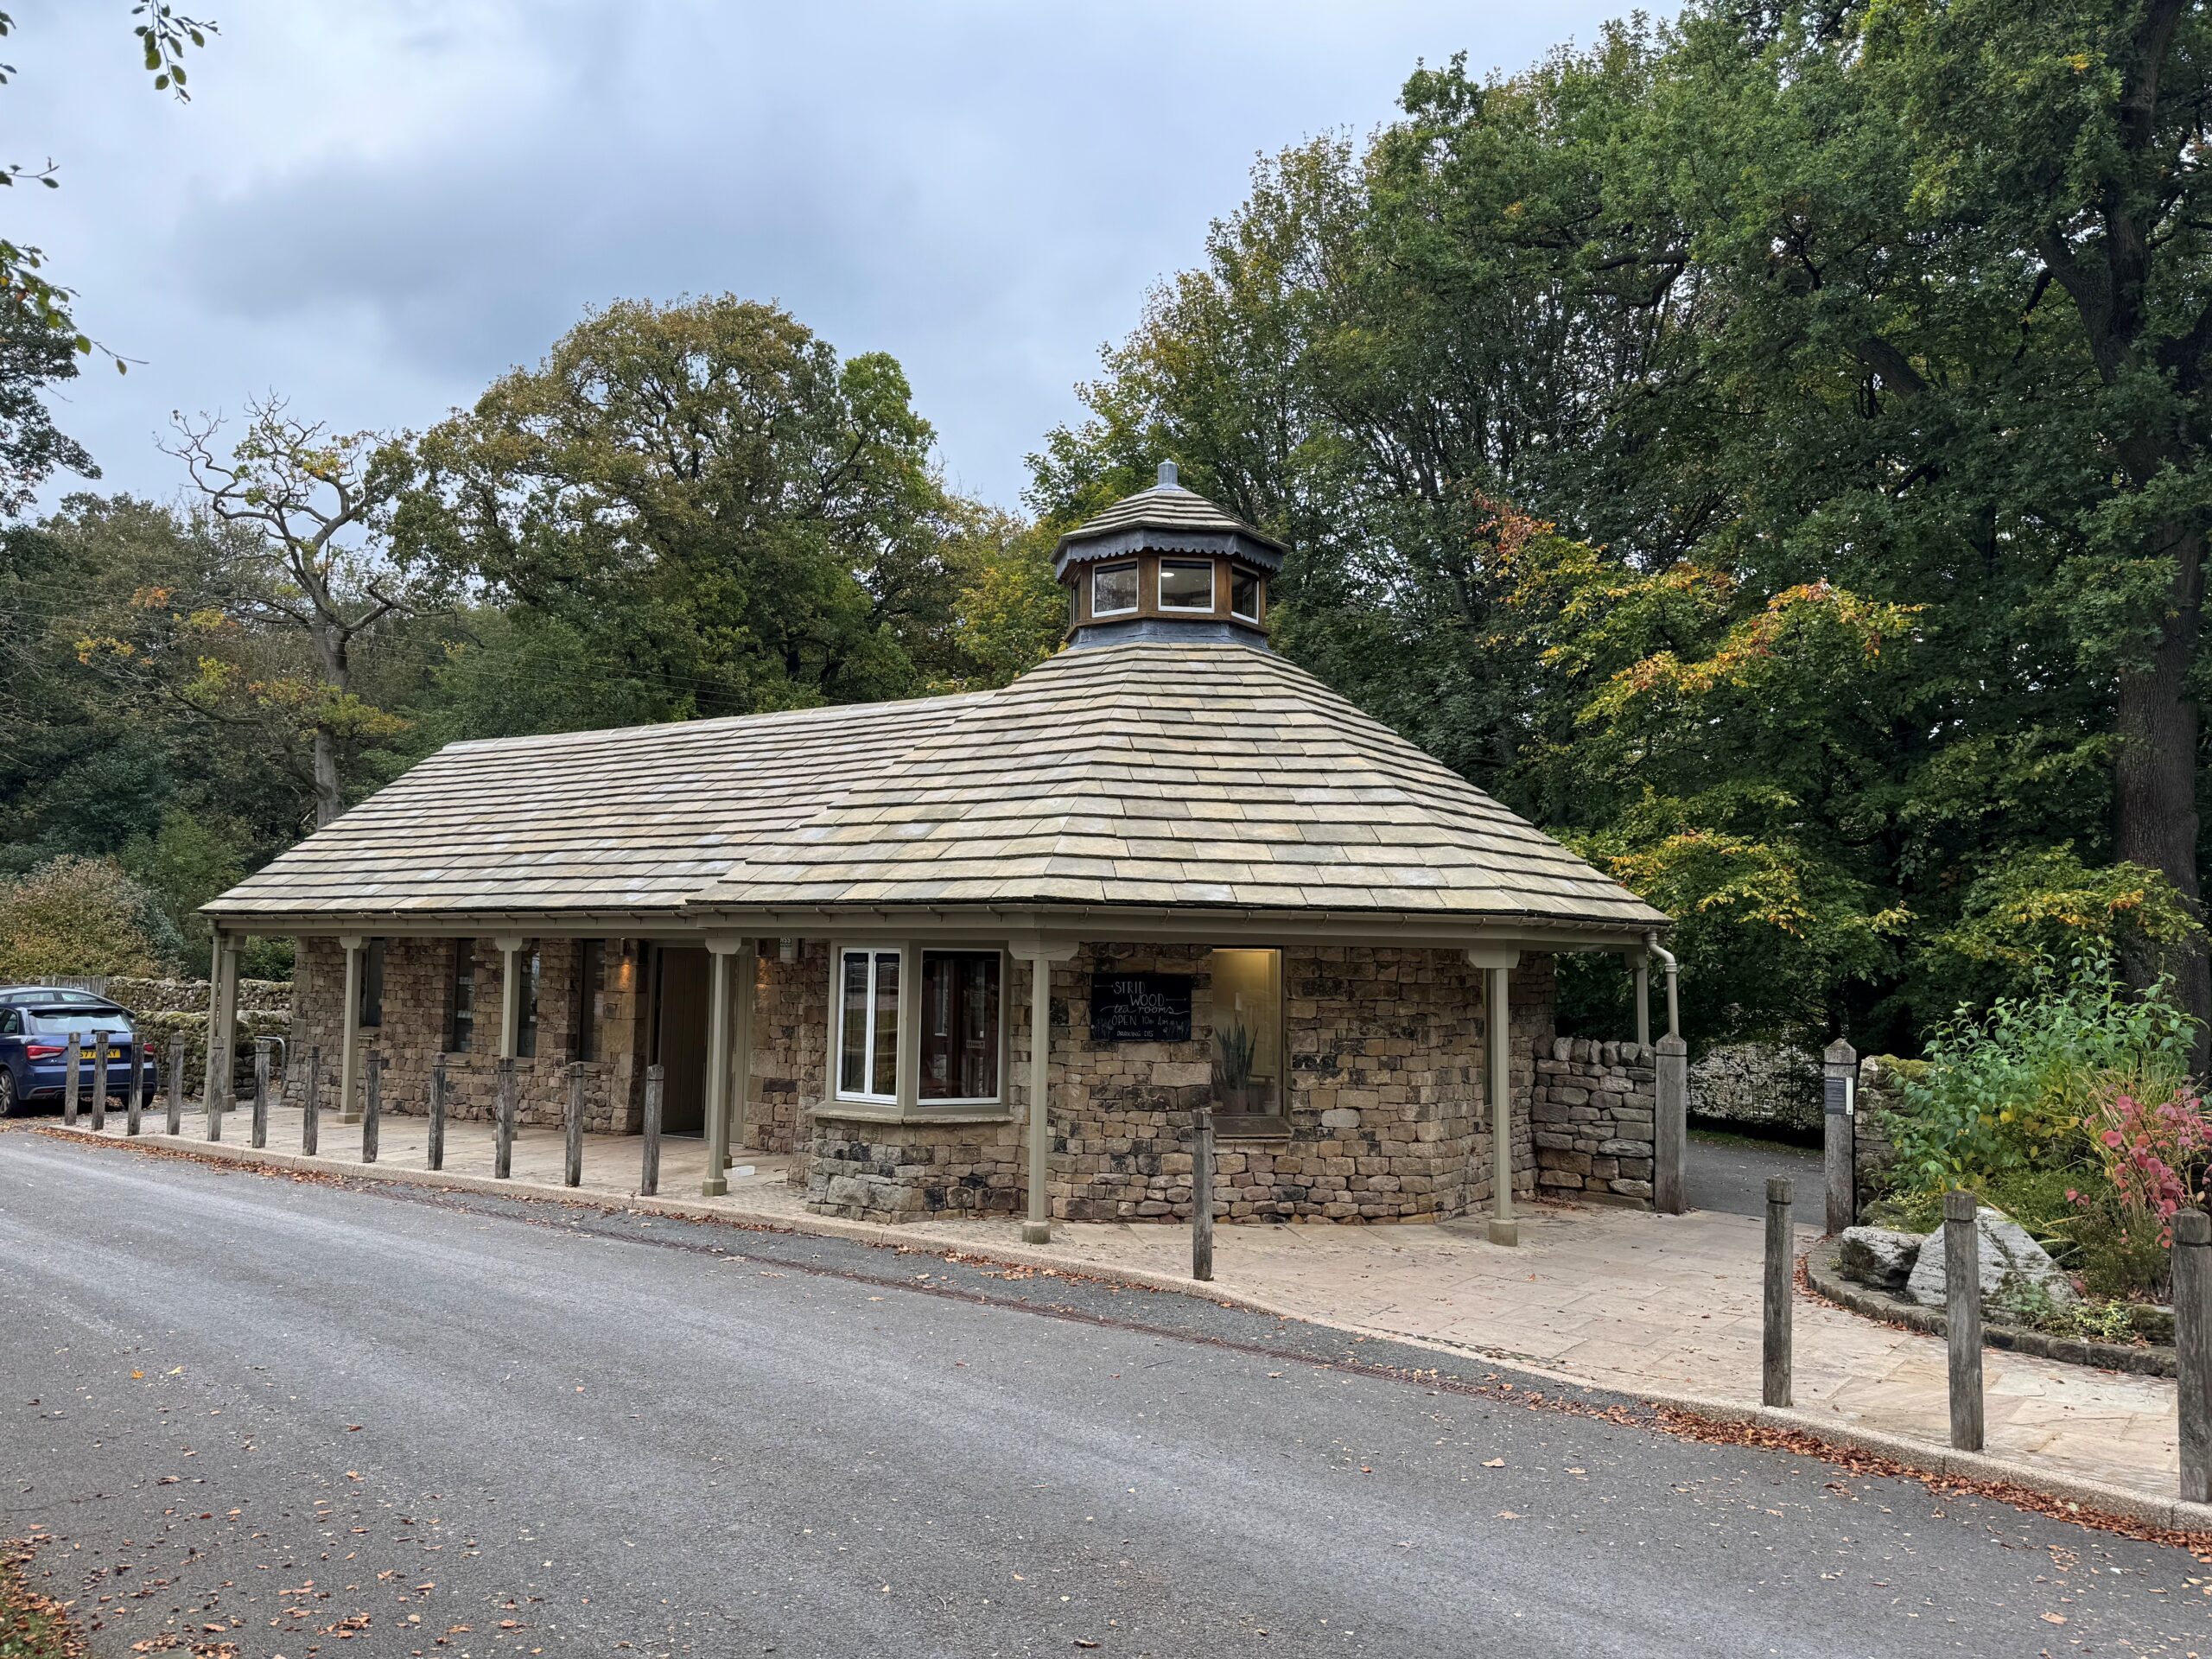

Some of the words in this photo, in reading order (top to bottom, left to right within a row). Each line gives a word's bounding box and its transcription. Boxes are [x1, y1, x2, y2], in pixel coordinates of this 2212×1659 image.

[1114, 981, 1146, 995] STRID
[1130, 994, 1165, 1007] WOOD
[1114, 1004, 1135, 1014] tea
[1139, 1006, 1174, 1014] rooms
[1111, 1014, 1137, 1026] OPEN
